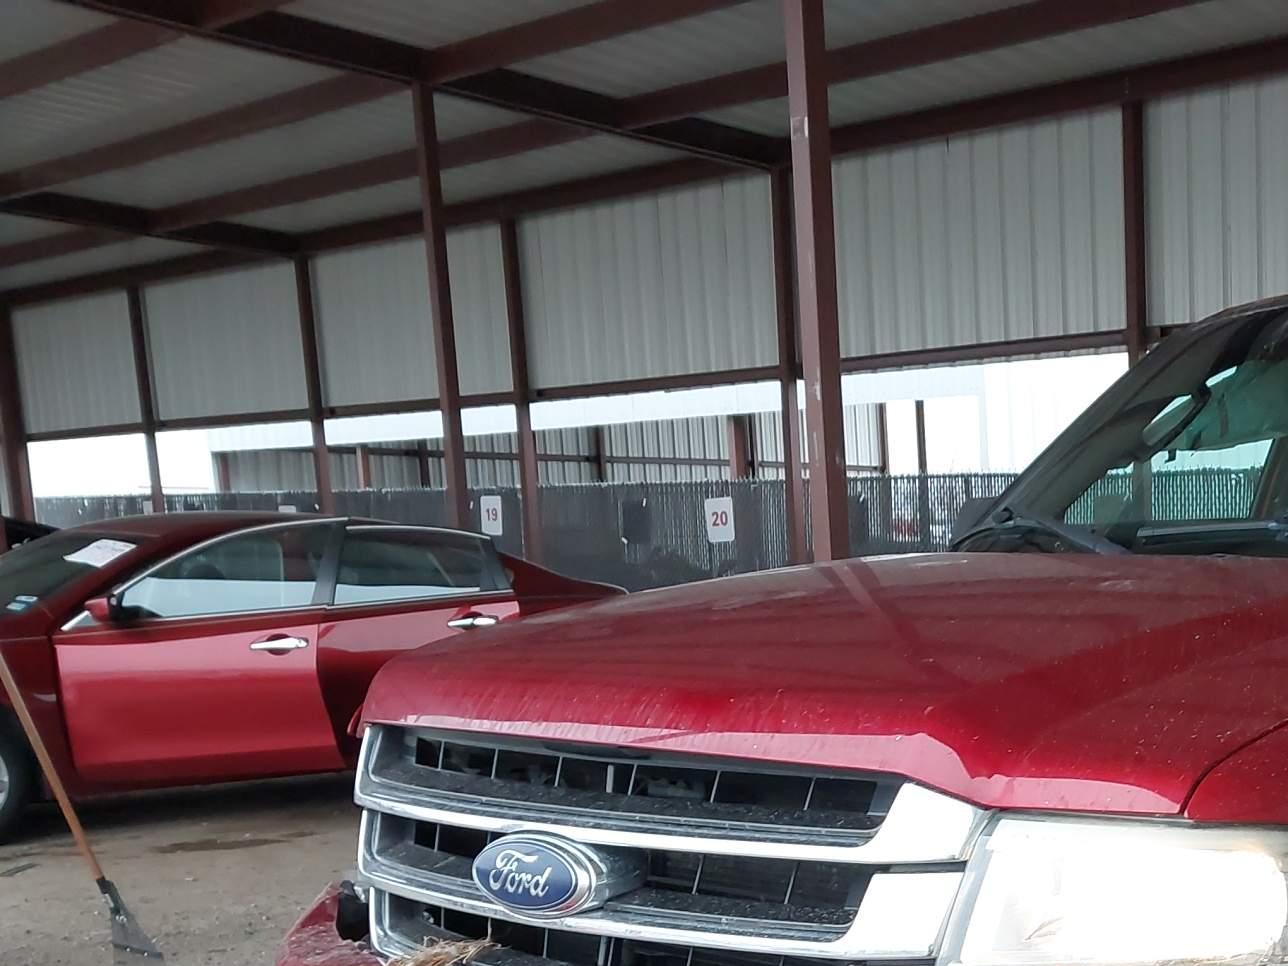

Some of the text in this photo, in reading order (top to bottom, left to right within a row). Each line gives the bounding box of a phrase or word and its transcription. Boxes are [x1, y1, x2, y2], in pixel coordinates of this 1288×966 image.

[486, 507, 498, 522] 19
[711, 510, 729, 527] 20
[488, 849, 553, 897] Ford
